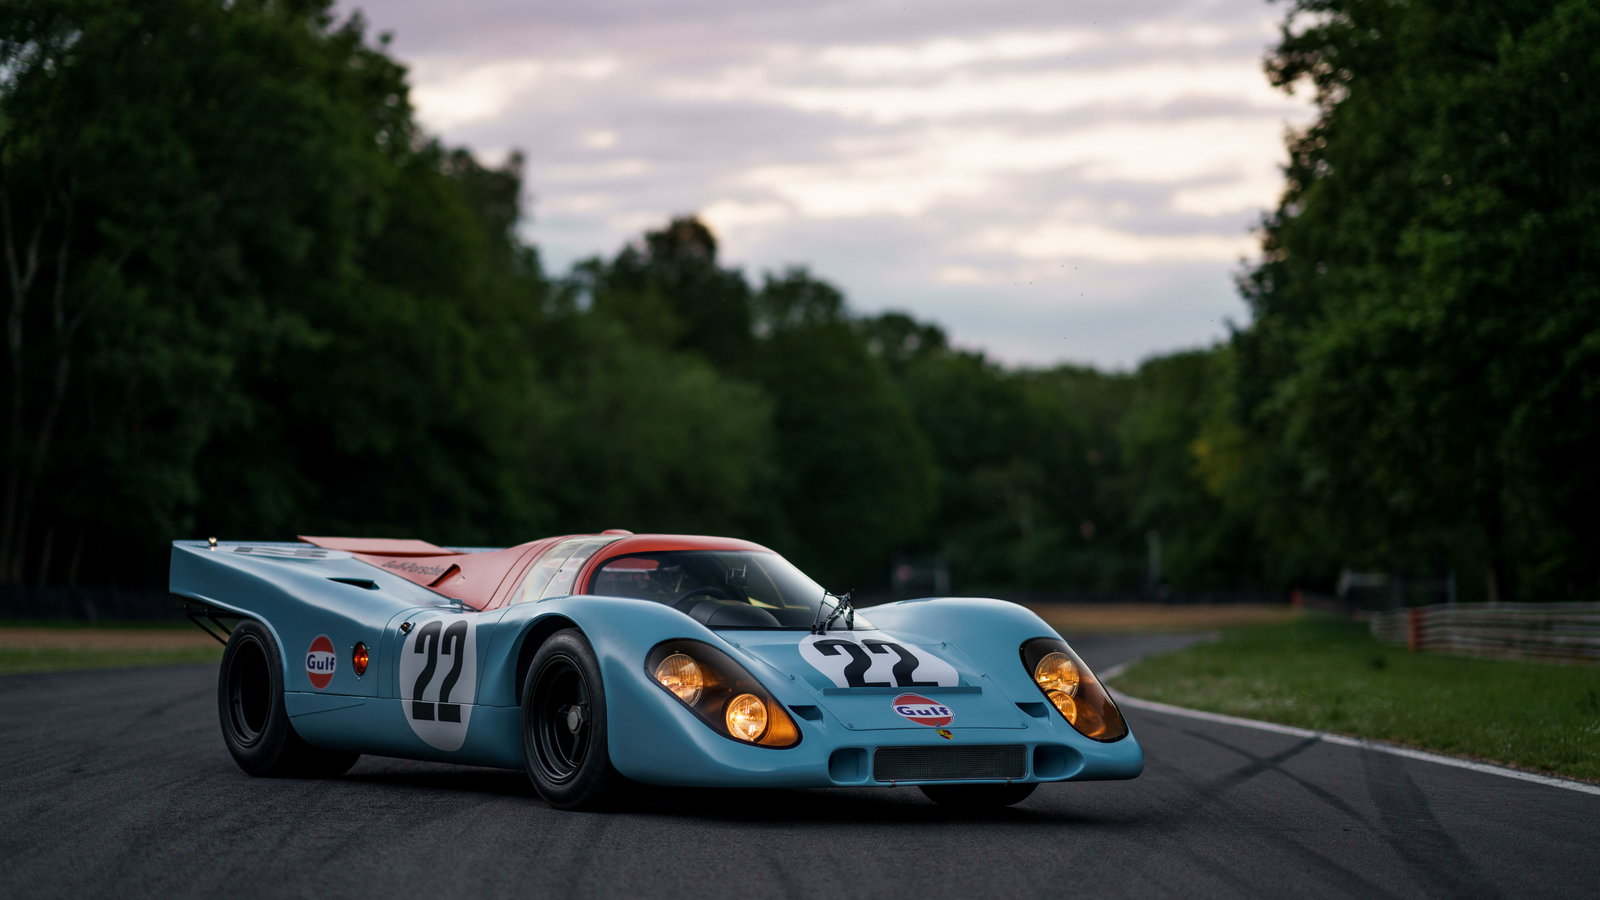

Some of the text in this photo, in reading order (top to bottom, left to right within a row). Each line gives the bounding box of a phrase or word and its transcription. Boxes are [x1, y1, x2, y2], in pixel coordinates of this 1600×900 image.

[307, 654, 335, 671] Gulf
[413, 620, 468, 723] 22
[813, 639, 939, 687] 22
[897, 706, 949, 716] Gulf
